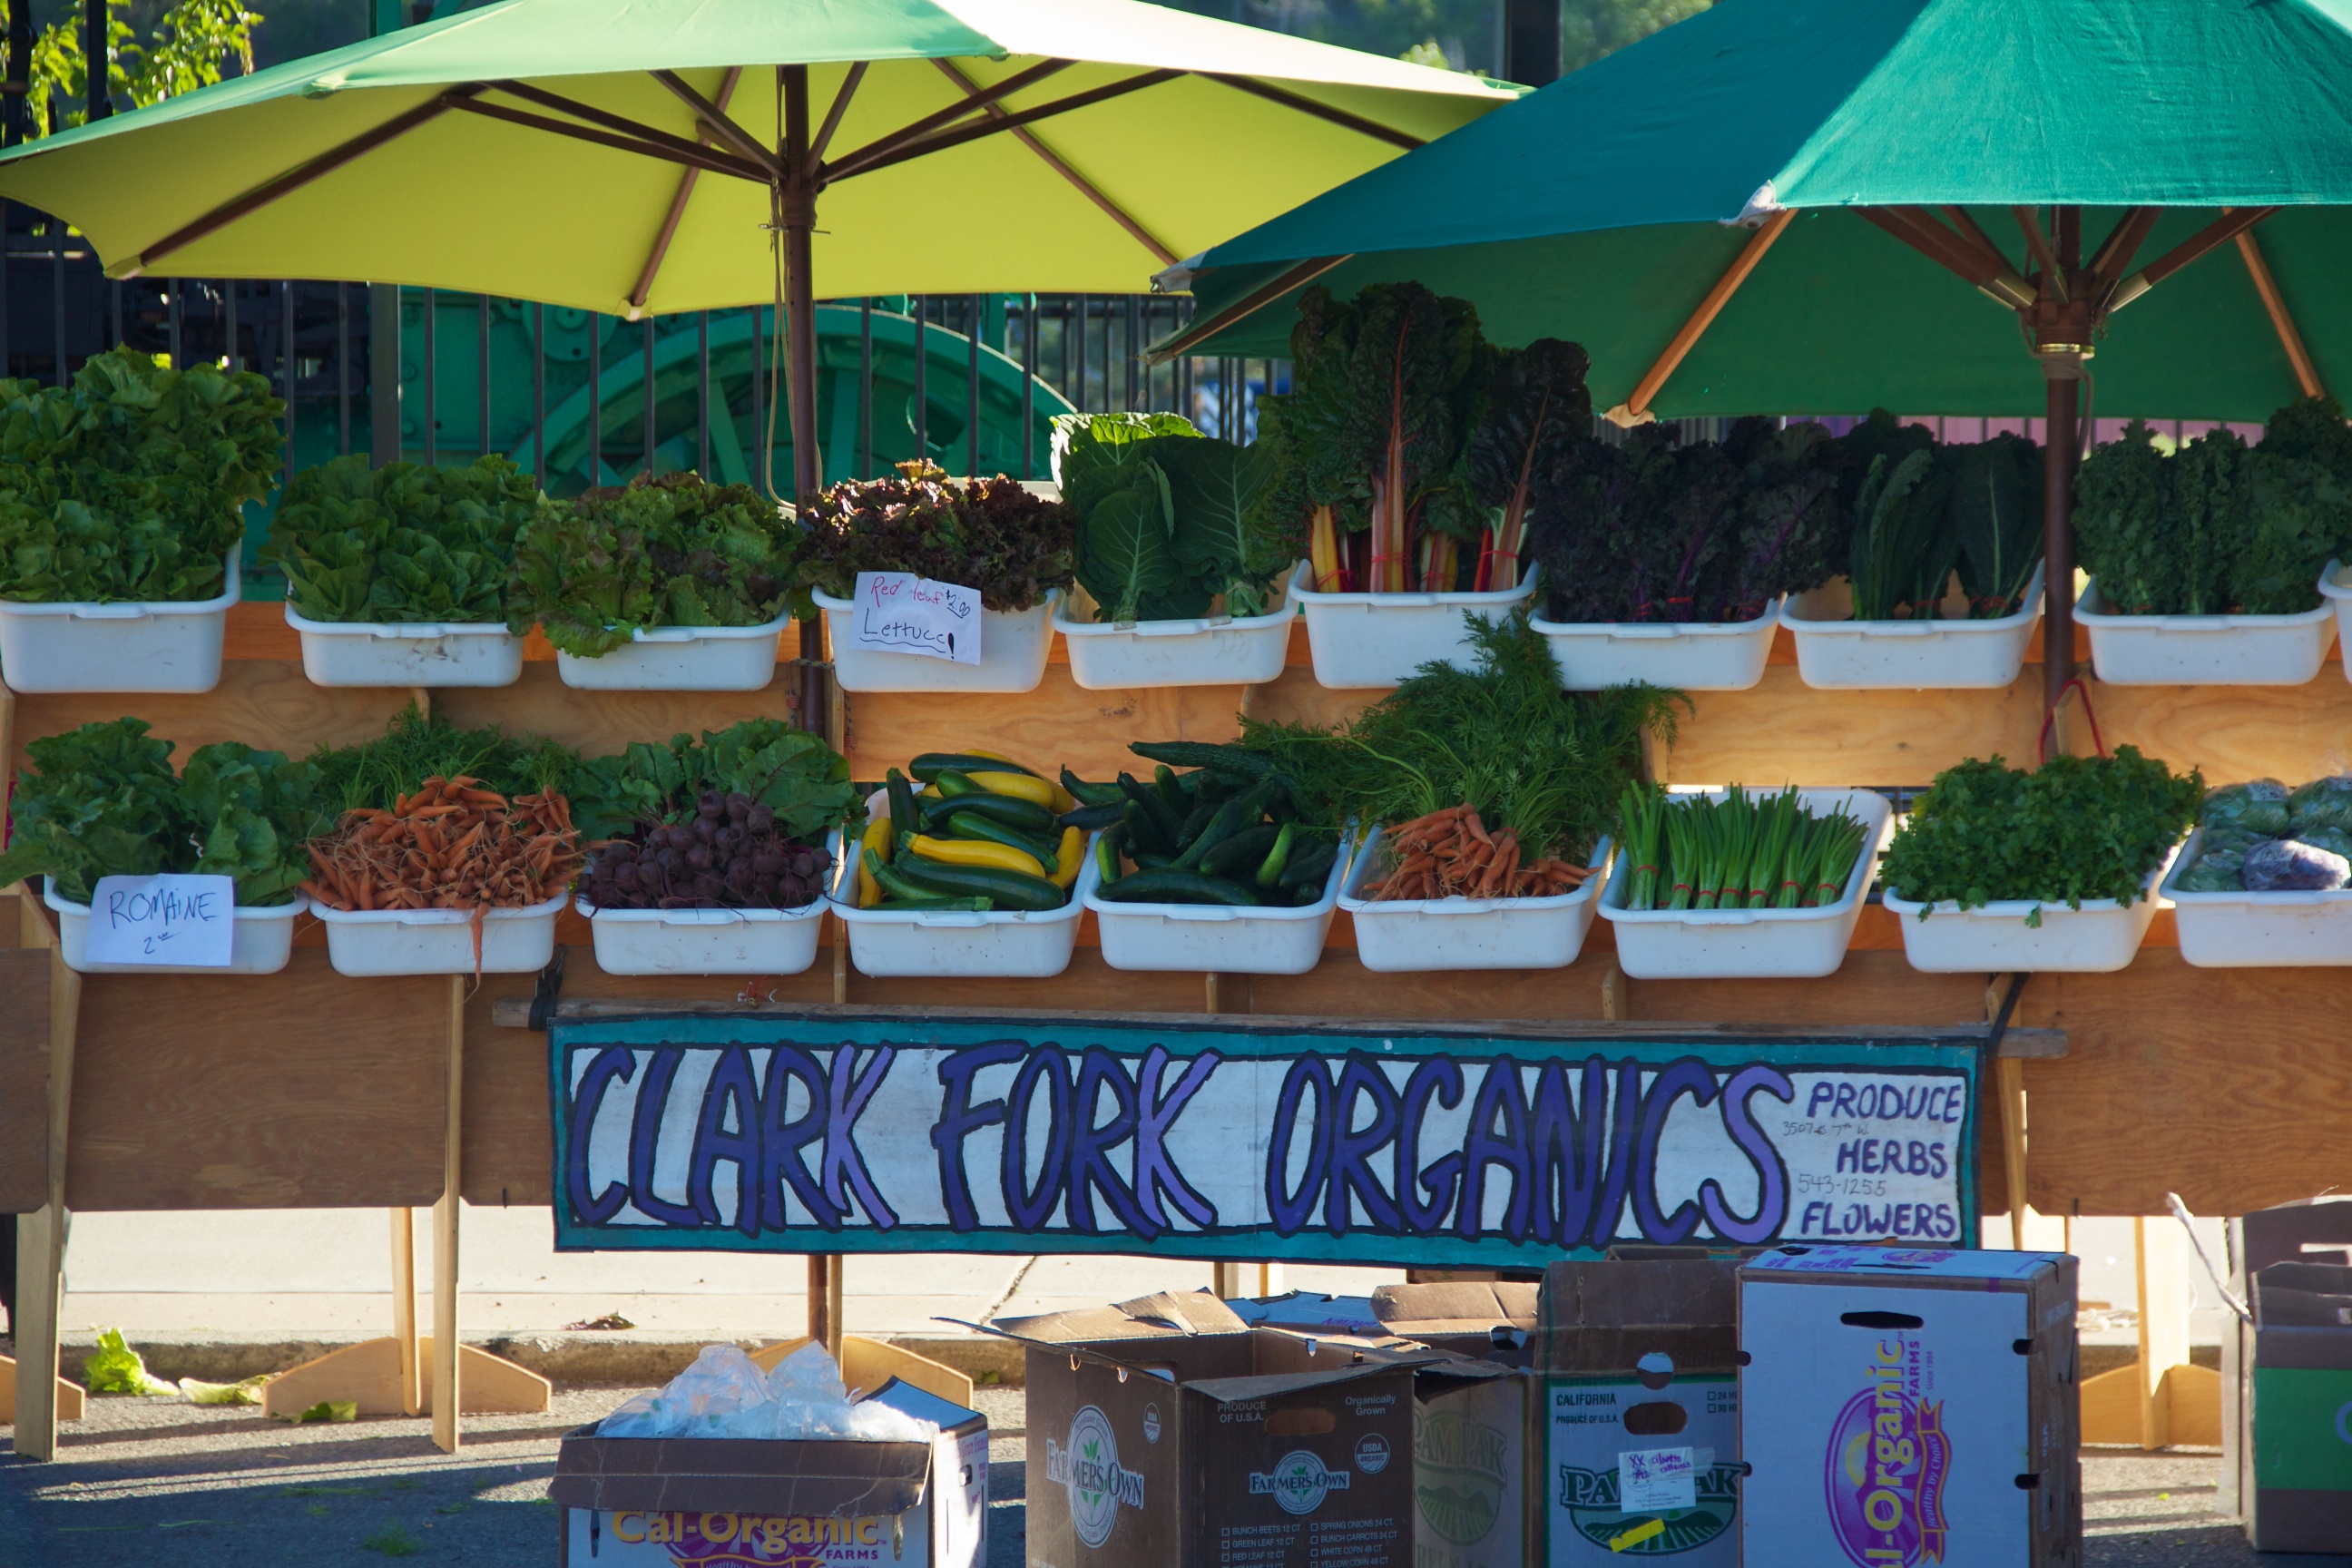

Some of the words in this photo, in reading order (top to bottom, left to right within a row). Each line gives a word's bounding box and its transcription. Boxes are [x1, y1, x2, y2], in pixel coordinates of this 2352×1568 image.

[871, 576, 903, 607] Red
[913, 581, 943, 604] leaf
[1807, 1082, 1963, 1123] PRODUCE
[566, 1040, 899, 1238] CLARK
[930, 1039, 1223, 1241] FORK
[1265, 1049, 1796, 1250] ORGANICS
[1837, 1139, 1948, 1180] HERBS
[1798, 1173, 1886, 1196] 543-1255
[1801, 1201, 1957, 1239] FLOWERS
[1926, 1351, 1935, 1368] 1984
[1909, 1341, 1920, 1397] FARMS
[1926, 1370, 1935, 1390] Since
[1345, 1394, 1397, 1406] Organically
[1556, 1393, 1616, 1406] CALIFORNIA
[1217, 1401, 1267, 1413] PRODUCE
[1356, 1407, 1387, 1416] Grown
[1220, 1414, 1233, 1423] OF
[1556, 1415, 1587, 1424] PRODUCE
[1589, 1415, 1597, 1423] OF
[1363, 1443, 1383, 1453] USDA
[1865, 1339, 1915, 1568] l-Organic
[1926, 1436, 1942, 1469] Choice
[1360, 1455, 1385, 1463] ORGANIC
[1927, 1472, 1940, 1485] by
[1925, 1486, 1939, 1528] Healthy
[612, 1511, 879, 1553] Cal-Organic
[1232, 1527, 1258, 1535] BUNCH
[1259, 1525, 1280, 1534] BEETS
[1283, 1524, 1290, 1533] 12
[1292, 1524, 1301, 1533] CT
[1320, 1522, 1347, 1531] SPRING
[1348, 1520, 1374, 1529] ONIONS
[1232, 1540, 1257, 1548] GREEN
[1258, 1539, 1274, 1547] LEAF
[1286, 1537, 1295, 1545] CT
[1321, 1535, 1345, 1544] BUNCH
[1347, 1533, 1377, 1543] CARROTS
[1388, 1531, 1397, 1539] CT
[826, 1550, 878, 1561] FARMS
[1232, 1553, 1248, 1562] RED
[1249, 1552, 1265, 1560] LEAF
[1276, 1551, 1285, 1559] CT
[1321, 1547, 1342, 1556] WHITE
[1343, 1546, 1363, 1555] CORN
[1373, 1544, 1383, 1553] CT
[1349, 1558, 1369, 1567] CORN
[1379, 1556, 1389, 1564] CT
